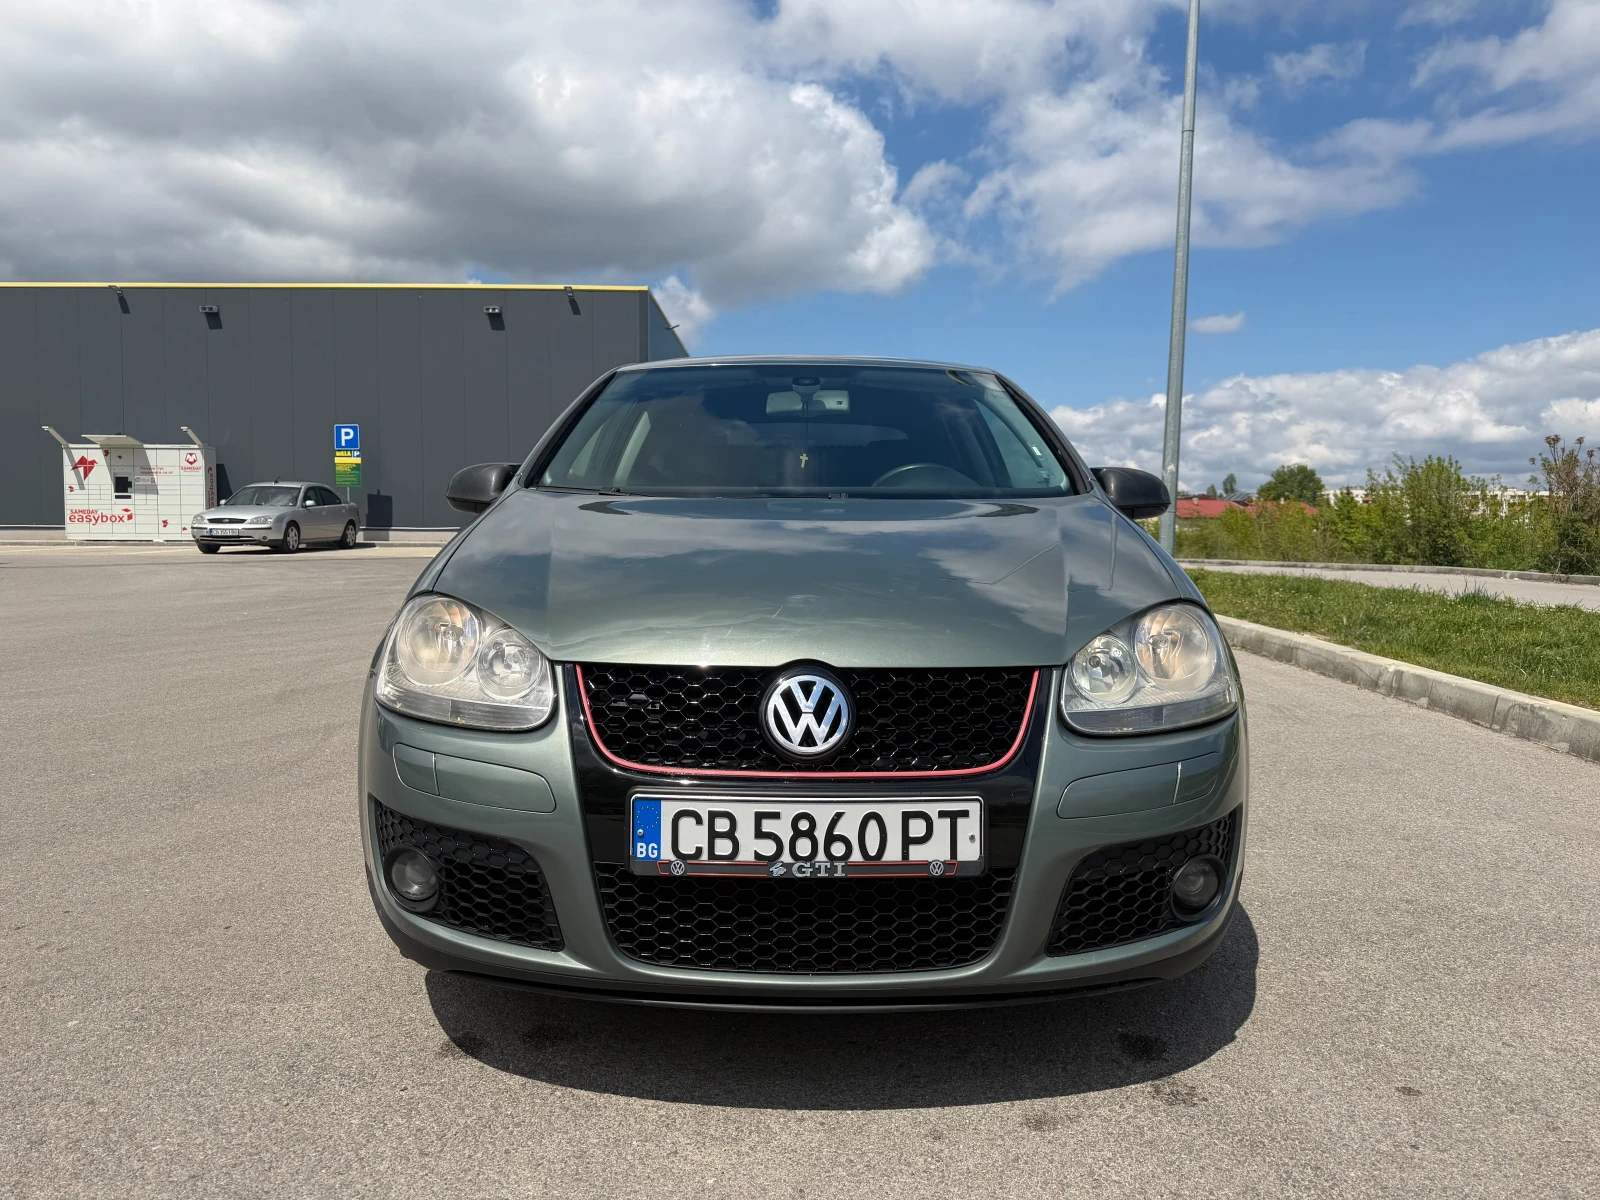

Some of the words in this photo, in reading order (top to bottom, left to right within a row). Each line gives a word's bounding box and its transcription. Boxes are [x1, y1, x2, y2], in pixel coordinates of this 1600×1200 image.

[341, 428, 354, 446] P
[69, 512, 125, 526] easybox
[767, 675, 849, 753] VW
[671, 809, 740, 861] CB
[753, 810, 888, 862] 5860
[901, 809, 970, 861] PT
[636, 843, 659, 858] BG
[792, 862, 846, 877] GTI
